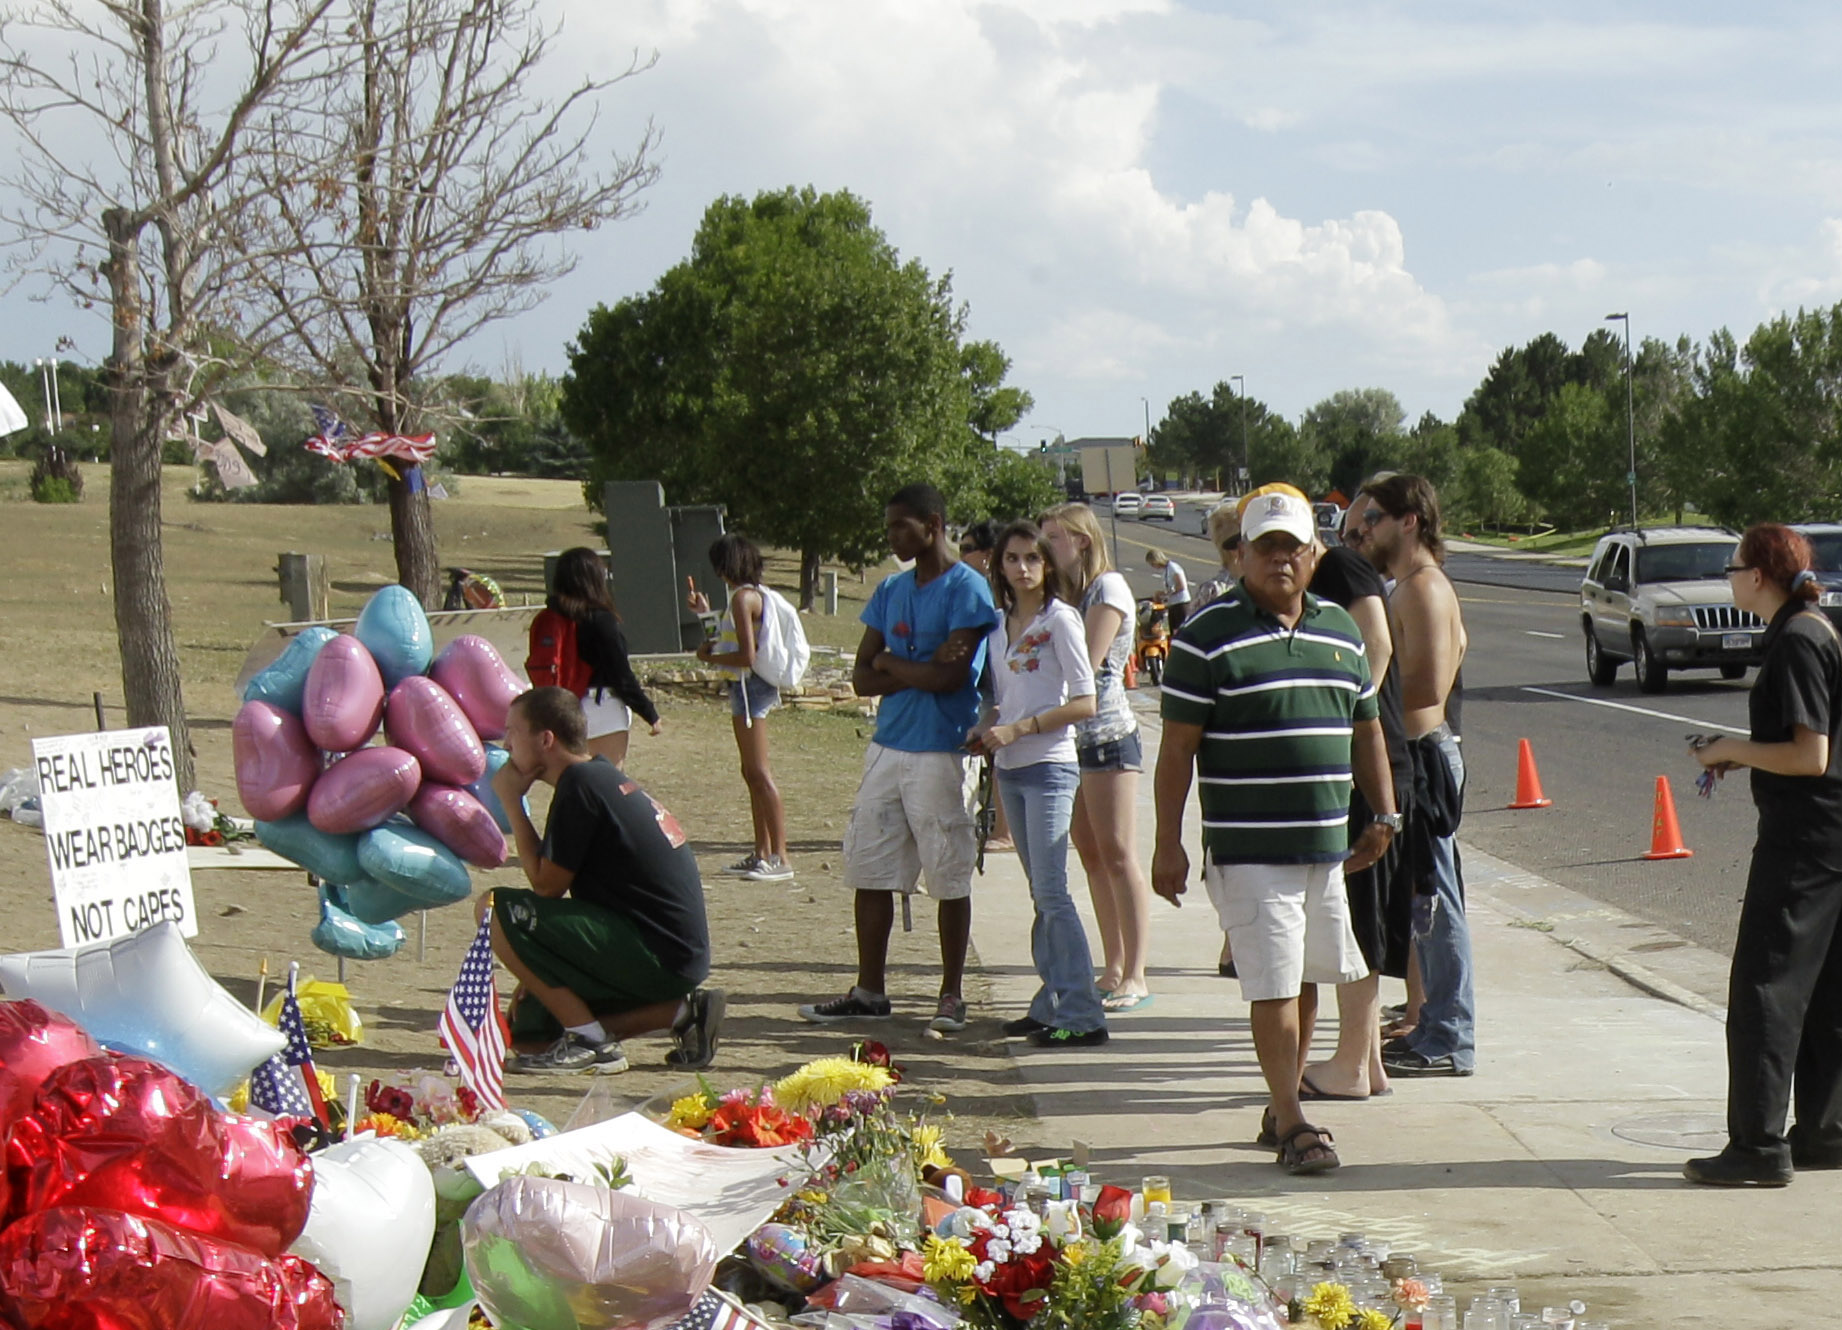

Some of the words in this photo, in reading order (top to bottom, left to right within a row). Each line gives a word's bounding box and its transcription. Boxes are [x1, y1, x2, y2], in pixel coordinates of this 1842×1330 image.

[37, 752, 95, 794] REAL
[99, 744, 173, 786] HEROES
[48, 827, 114, 871] WEAR
[114, 817, 185, 860] BADGES
[71, 899, 113, 943] NOT
[123, 889, 184, 932] CAPES
